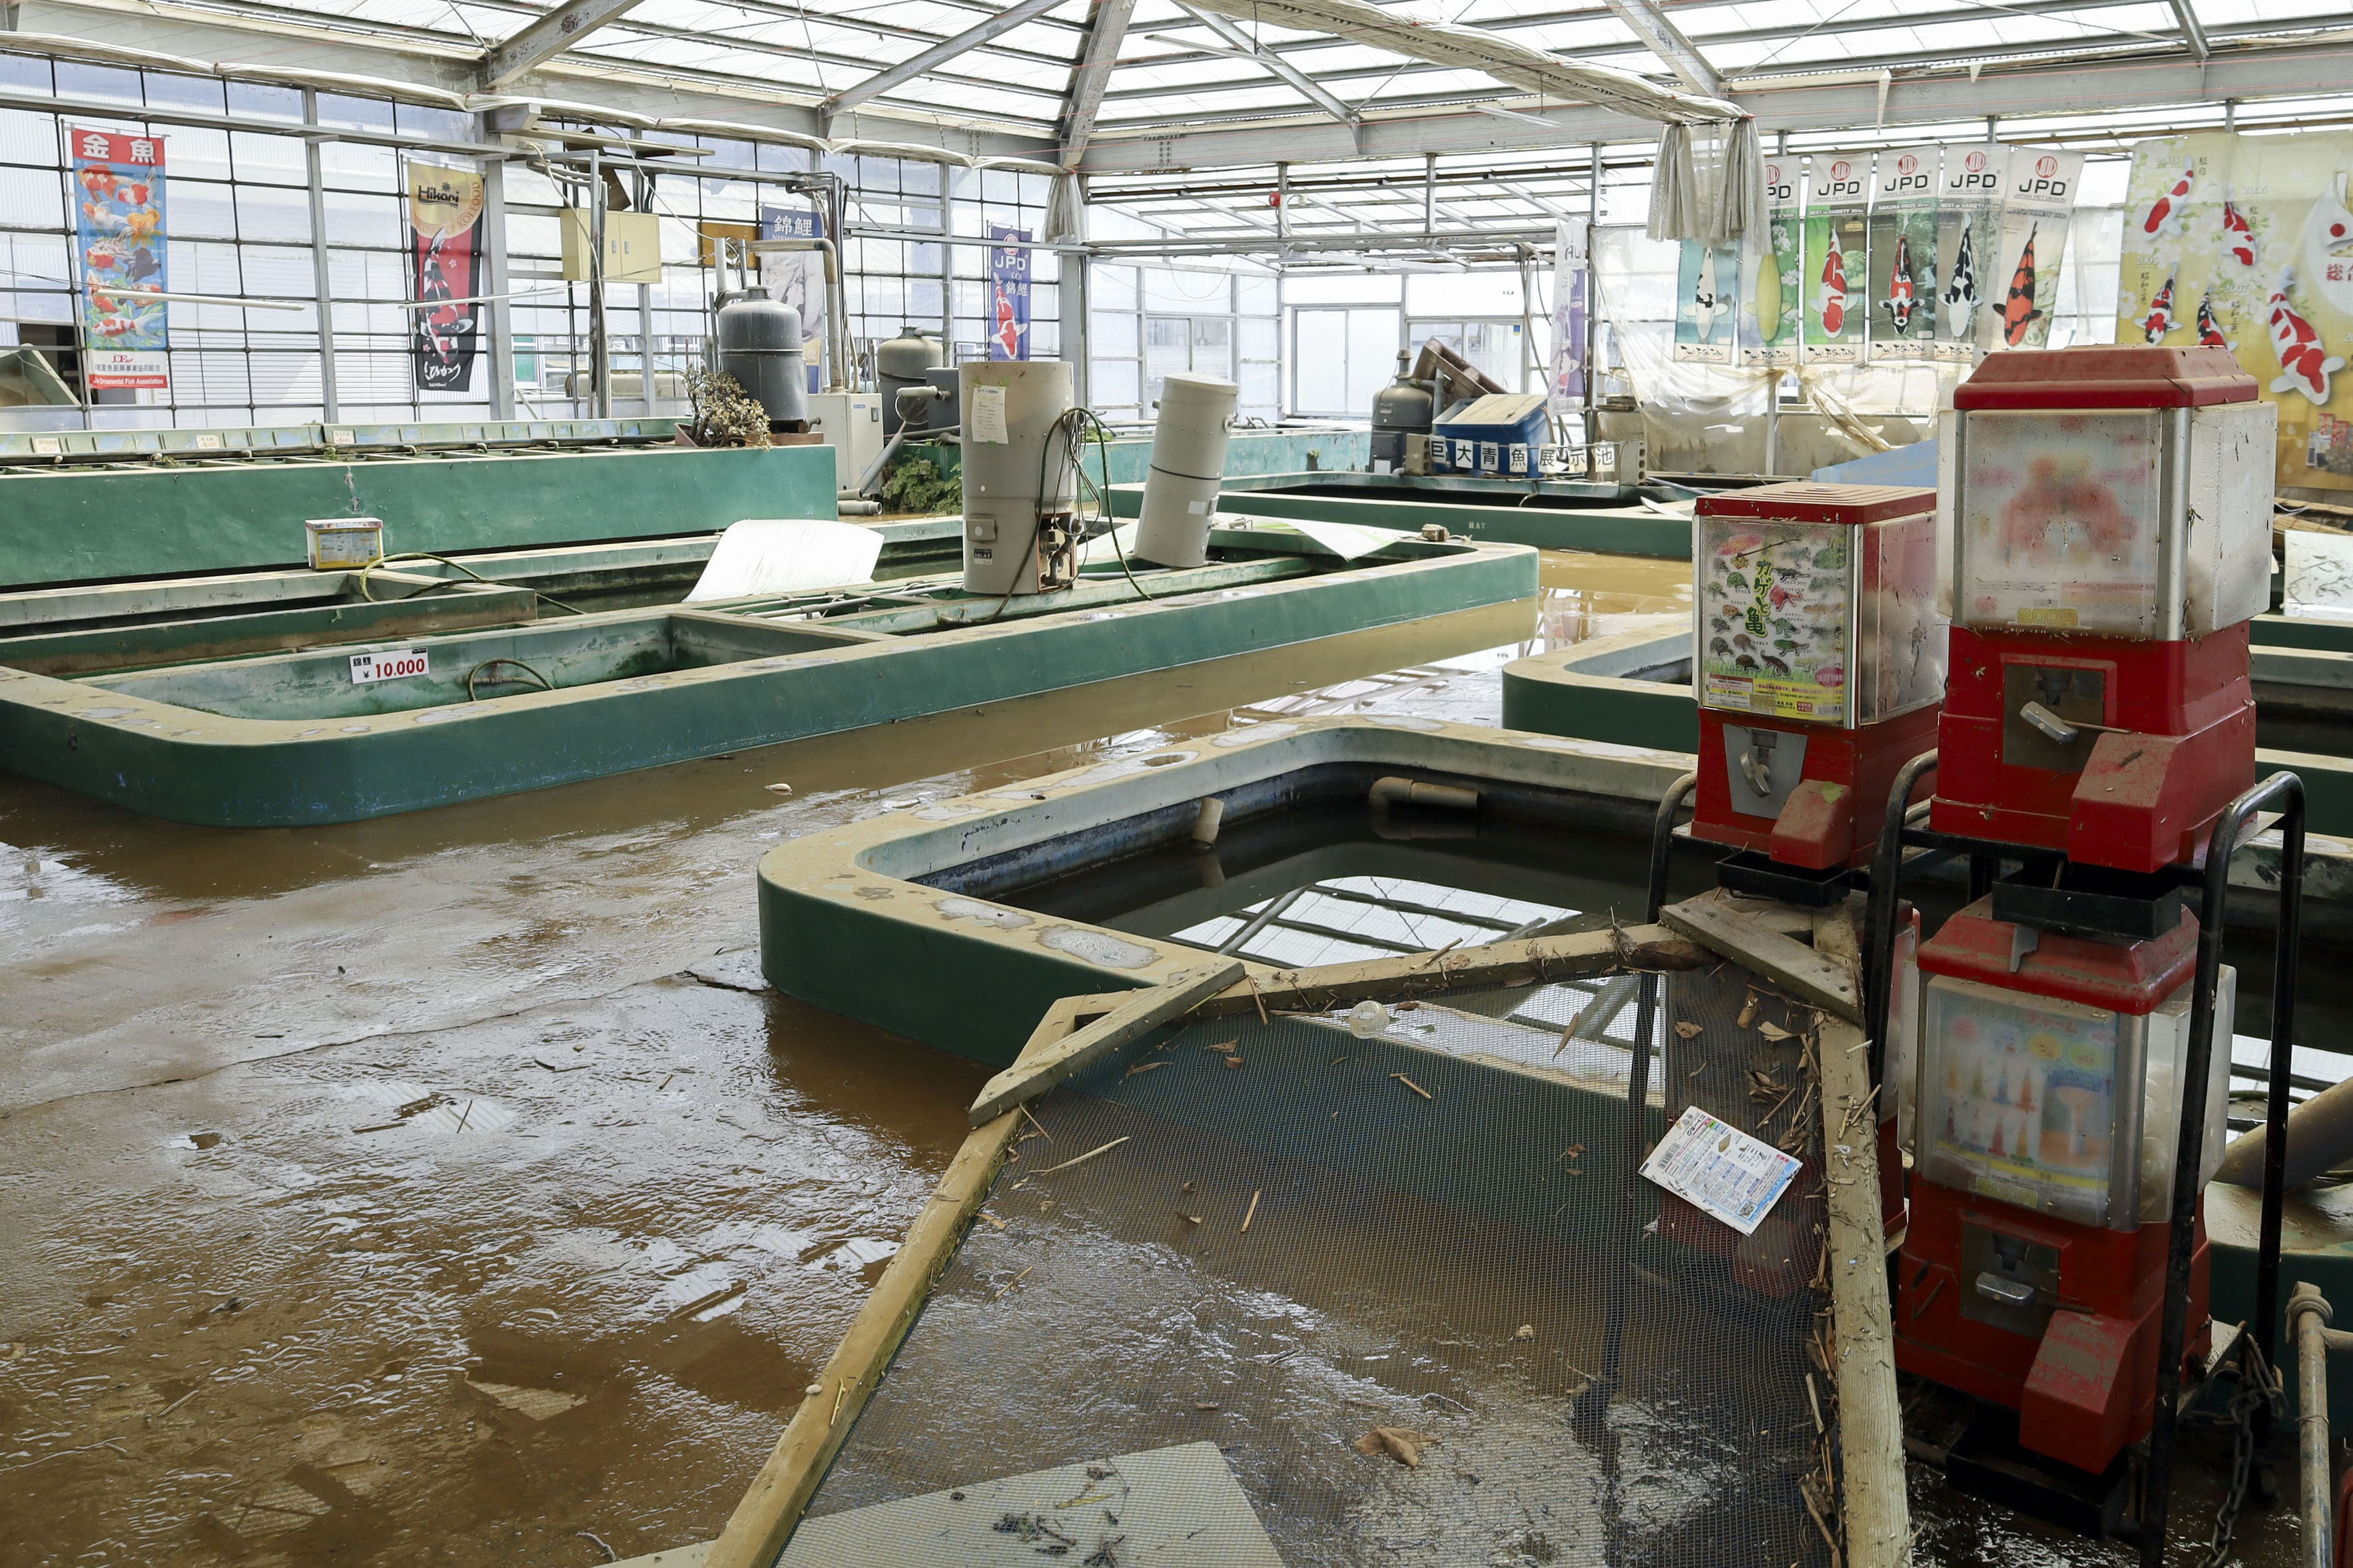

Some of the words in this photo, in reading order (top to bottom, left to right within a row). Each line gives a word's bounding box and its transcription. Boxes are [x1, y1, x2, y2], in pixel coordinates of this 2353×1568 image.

[83, 134, 155, 163] 金魚
[1818, 181, 1860, 195] JPD
[1885, 174, 1928, 191] JPD
[1951, 174, 1997, 188] JPD
[2019, 178, 2066, 196] JPD
[418, 185, 460, 203] Hikari
[774, 215, 813, 236] 錦鯉
[995, 255, 1026, 271] JPD
[1432, 441, 1613, 467] 巨大青魚展示池
